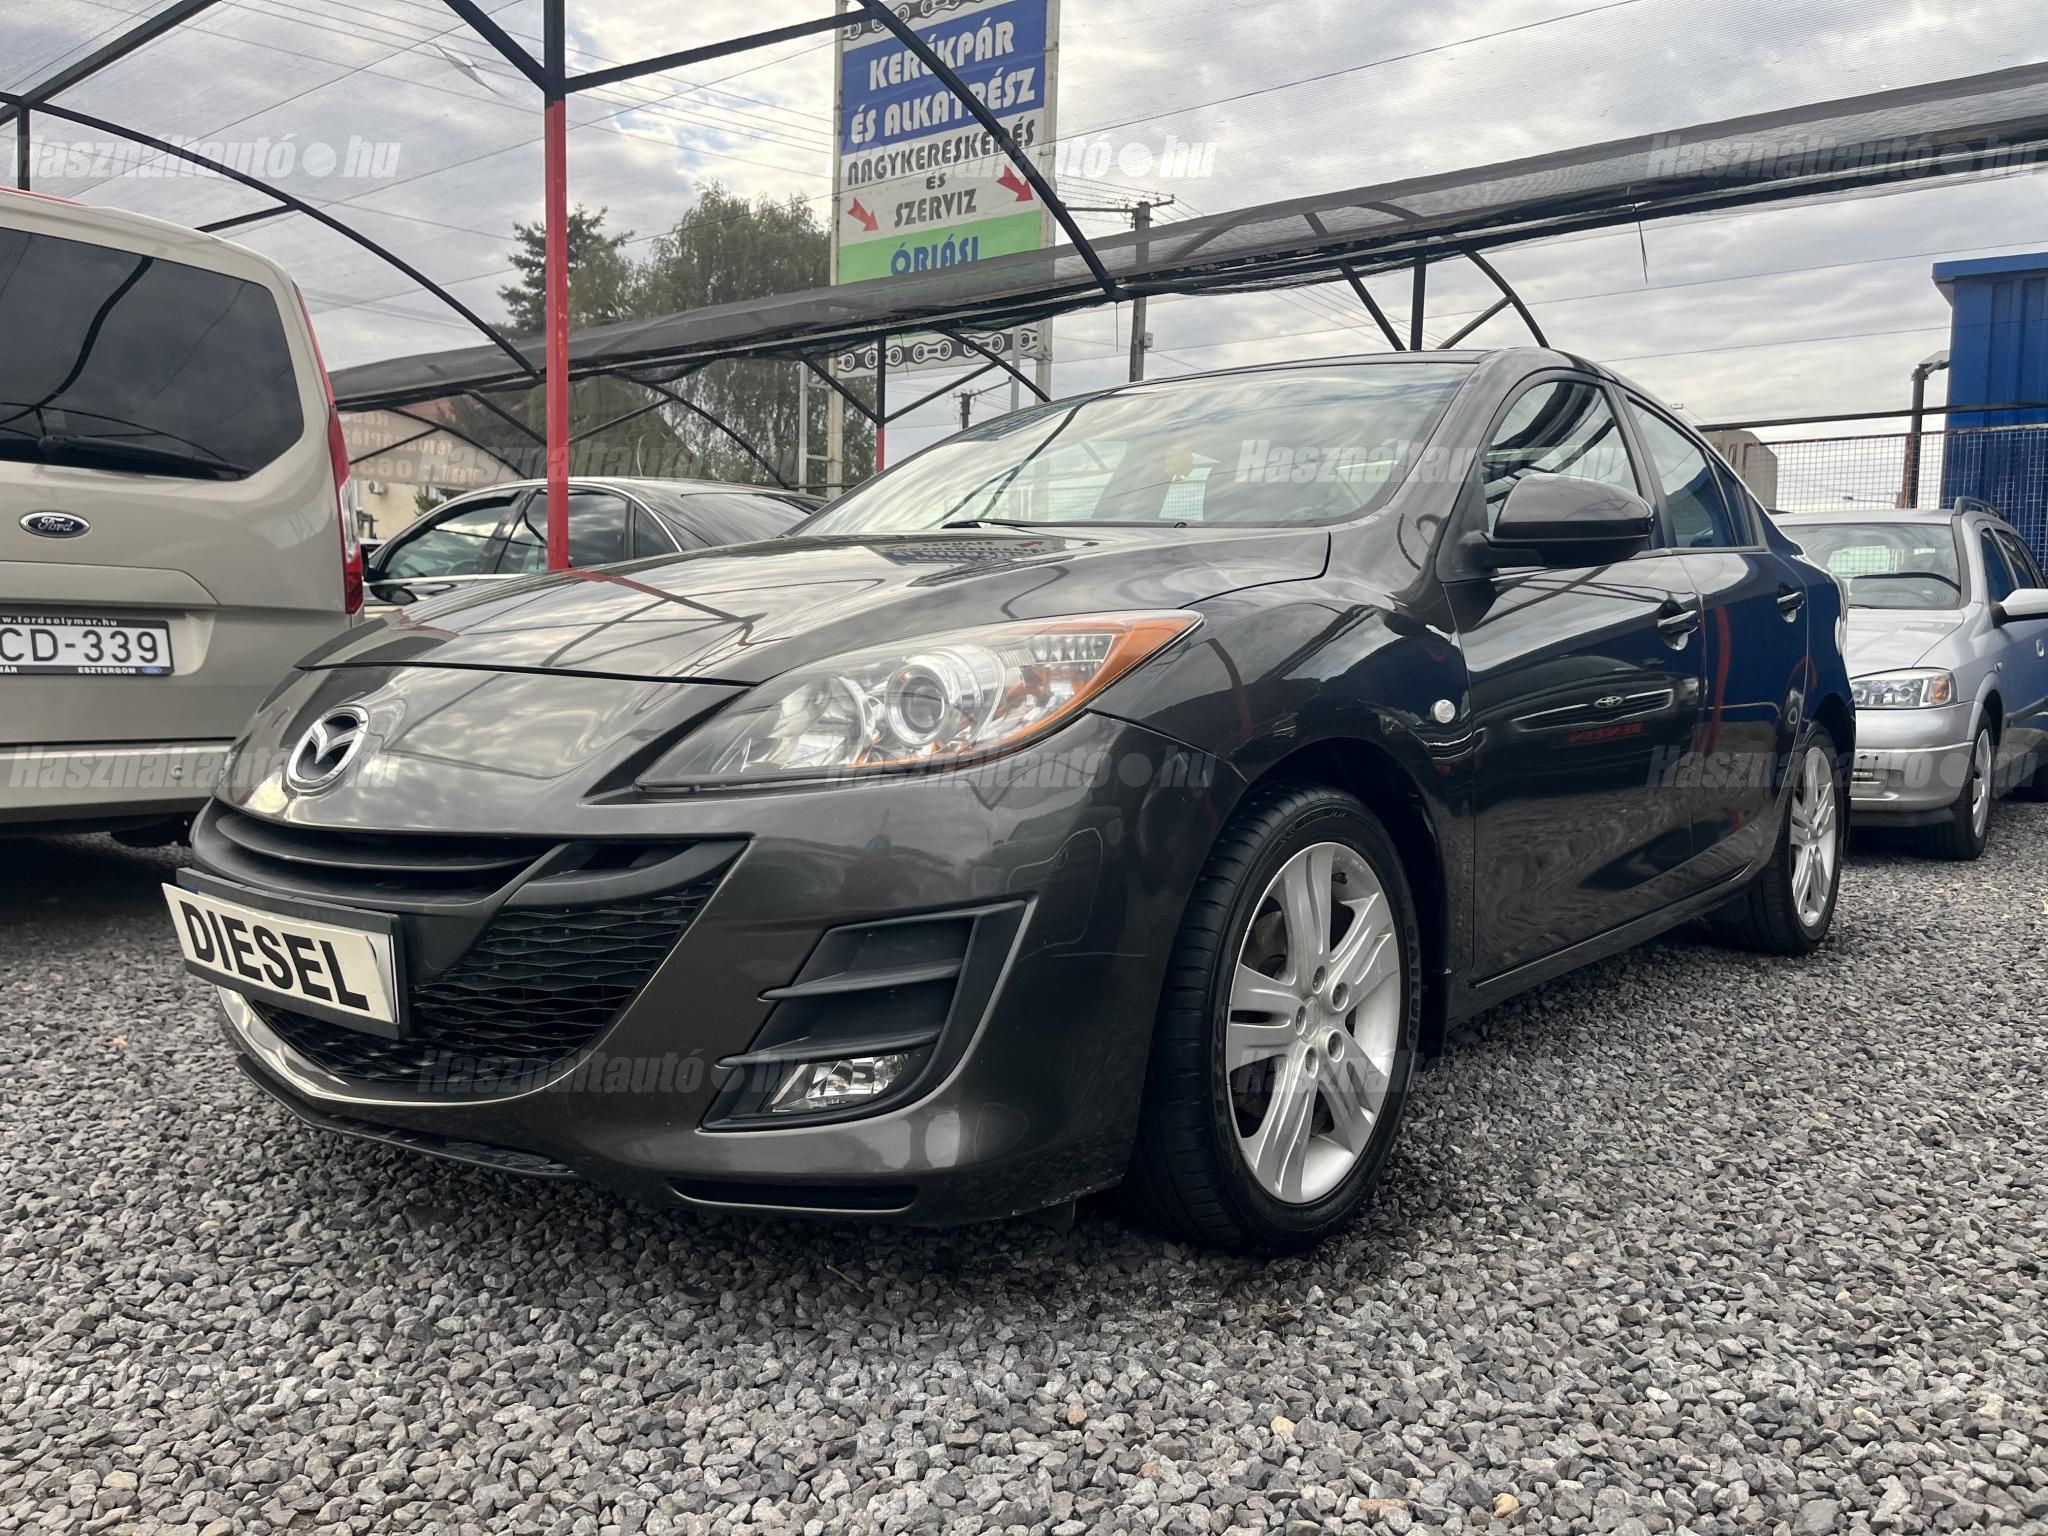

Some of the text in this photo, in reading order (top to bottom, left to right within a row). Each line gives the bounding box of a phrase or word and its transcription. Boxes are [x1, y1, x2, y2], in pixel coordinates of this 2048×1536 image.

[851, 104, 876, 144] ÉS
[926, 172, 946, 190] ÉS
[894, 188, 977, 228] SZERVIZ
[891, 233, 979, 275] ÓRIÁSI
[37, 515, 74, 533] Ford
[0, 627, 158, 663] CD-339
[78, 666, 136, 675] ESZTERGOM
[180, 900, 370, 1012] DIESEL
